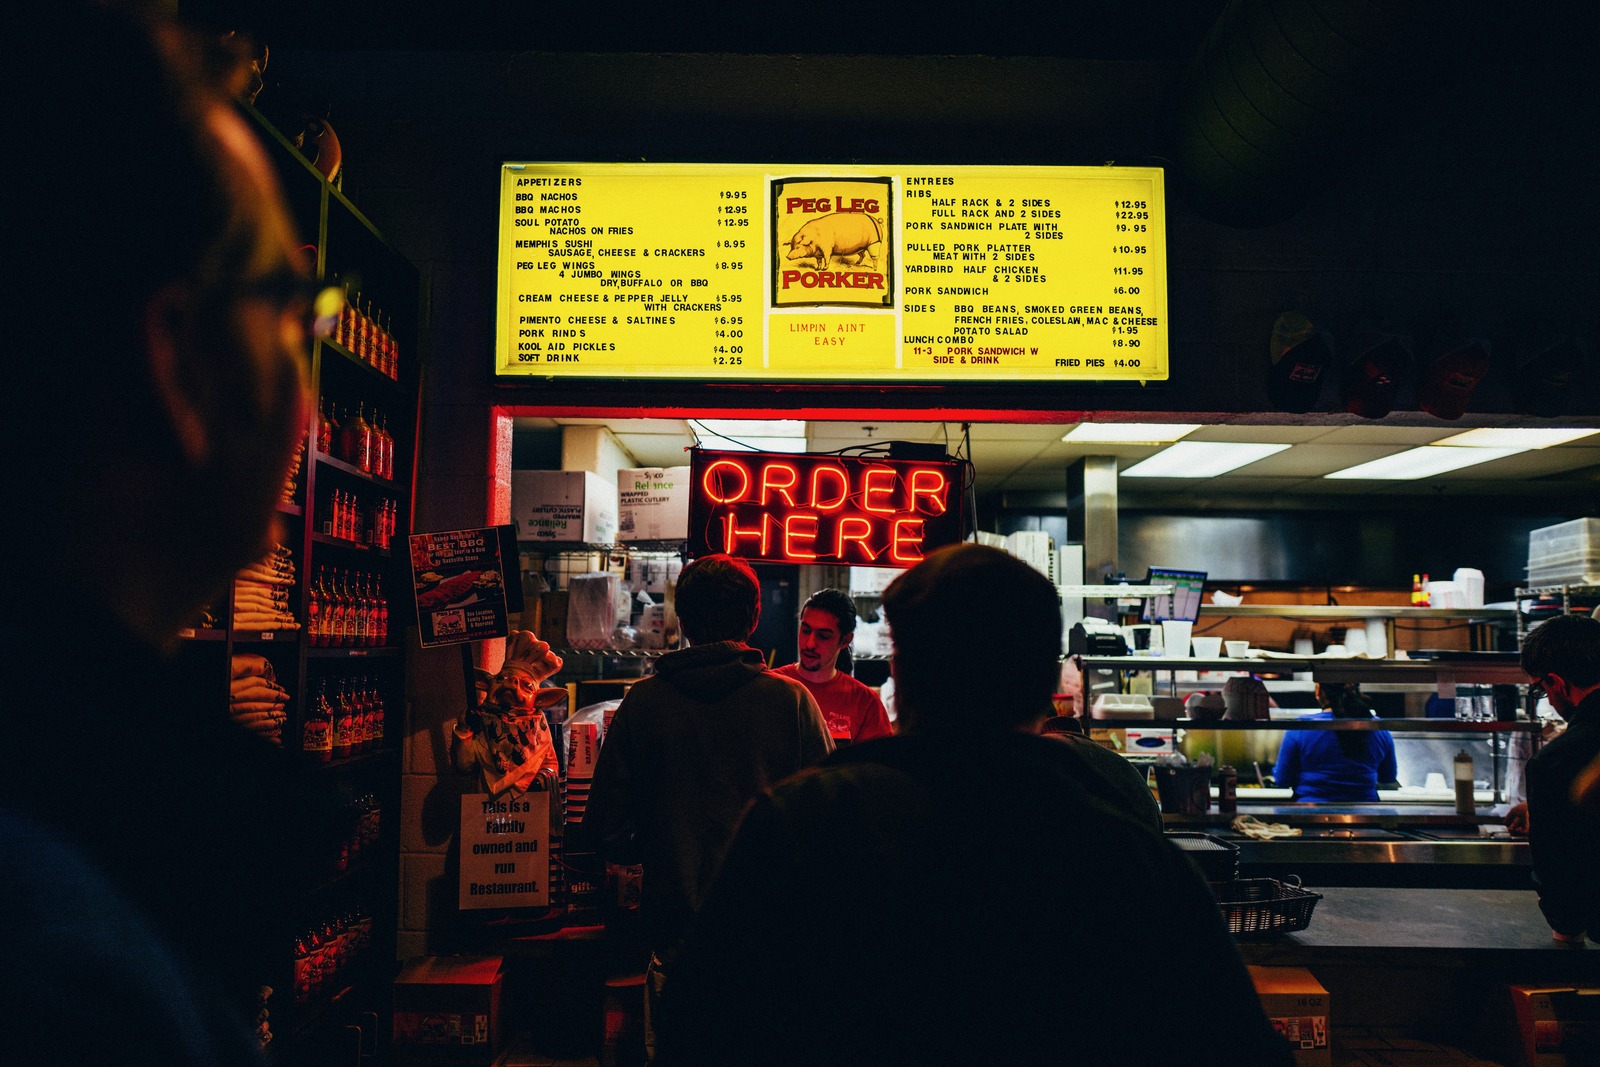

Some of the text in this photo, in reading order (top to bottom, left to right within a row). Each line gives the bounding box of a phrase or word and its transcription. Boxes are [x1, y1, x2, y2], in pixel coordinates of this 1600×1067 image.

[517, 178, 581, 186] APPETIZERS
[907, 177, 954, 185] ENTREES
[516, 191, 747, 201] BBQ NACHOS $9.95
[907, 190, 931, 198] RIBS
[786, 196, 880, 214] PEG LEG
[996, 199, 1002, 207] &
[1009, 199, 1014, 207] 2
[1022, 199, 1050, 207] SIDES
[1115, 201, 1146, 209] $12.95
[515, 206, 533, 214] BBQ
[718, 206, 747, 214] $12.95
[932, 209, 955, 217] FULL
[1031, 210, 1061, 218] SIDES
[1116, 211, 1148, 220] $22.95
[515, 219, 539, 227] SOUL
[545, 218, 579, 226] POTATO
[906, 222, 933, 230] PORK
[941, 222, 992, 230] SANDWICH
[1034, 223, 1057, 231] WITH
[1116, 224, 1146, 232] $9.95
[550, 227, 633, 235] NACHOS ON FRIES
[515, 240, 745, 248] MEMPHIS SUSHI $8.95
[907, 243, 945, 251] PULLED
[987, 244, 1031, 252] PLATTER
[1113, 246, 1146, 254] $10.95
[548, 249, 594, 259] SAUSAGE,
[598, 249, 636, 257] CHEESE
[933, 252, 958, 260] MEAT
[1005, 253, 1035, 261] SIDES
[517, 262, 533, 270] PEG
[715, 262, 743, 270] $8.95
[905, 265, 953, 273] YARDBIRD
[994, 266, 1038, 274] CHICKEN
[1114, 267, 1143, 275] $11.95
[559, 270, 641, 278] 4 JUMBO WINGS
[670, 279, 682, 287] OR
[691, 279, 708, 287] BBQ
[782, 270, 885, 290] PORKER
[1015, 275, 1046, 283] SIDES
[905, 287, 932, 295] PORK
[938, 287, 988, 295] SANDWICH
[518, 294, 552, 302] CREAM
[560, 294, 599, 302] CHEESE
[603, 294, 609, 302] &
[614, 294, 653, 302] PEPPER
[660, 294, 688, 302] JELLY
[644, 303, 721, 311] WITH CRACKERS
[904, 304, 935, 312] SIDES
[954, 305, 974, 313] BBQ
[983, 305, 1019, 315] BEANS,
[1070, 306, 1102, 314] GREEN
[1109, 306, 1143, 316] BEANS,
[520, 316, 561, 324] PIMENTO
[568, 316, 606, 324] CHEESE
[612, 316, 618, 324] &
[627, 316, 675, 324] SALTINES
[955, 316, 991, 324] FRENCH
[996, 316, 1028, 325] FRIES,
[790, 322, 866, 333] LIMPIN AINT
[954, 326, 1138, 335] POTATO SALAD $1.95
[519, 329, 743, 338] PORK RINDS $4.00
[814, 336, 846, 347] EASY
[904, 336, 1140, 347] LUNCH COMBO $8.90
[518, 343, 542, 351] KOOL
[573, 343, 615, 351] PICKLES
[914, 347, 932, 355] 11-3
[947, 347, 973, 355] PORK
[978, 347, 1025, 355] SANDWICH
[518, 354, 742, 365] SOFT DRINK $2.25
[933, 356, 999, 364] SIDE & DRINK
[1055, 359, 1140, 367] FRIED PIES $4.00
[703, 460, 947, 513] ORDER
[528, 519, 567, 530] Reliance
[725, 512, 925, 561] HERE
[427, 539, 485, 551] BEST BBQ
[509, 800, 521, 814] is
[523, 801, 531, 813] a
[486, 820, 526, 834] Family
[472, 840, 538, 855] owned and
[494, 862, 516, 875] run
[470, 881, 540, 896] Restaurant.
